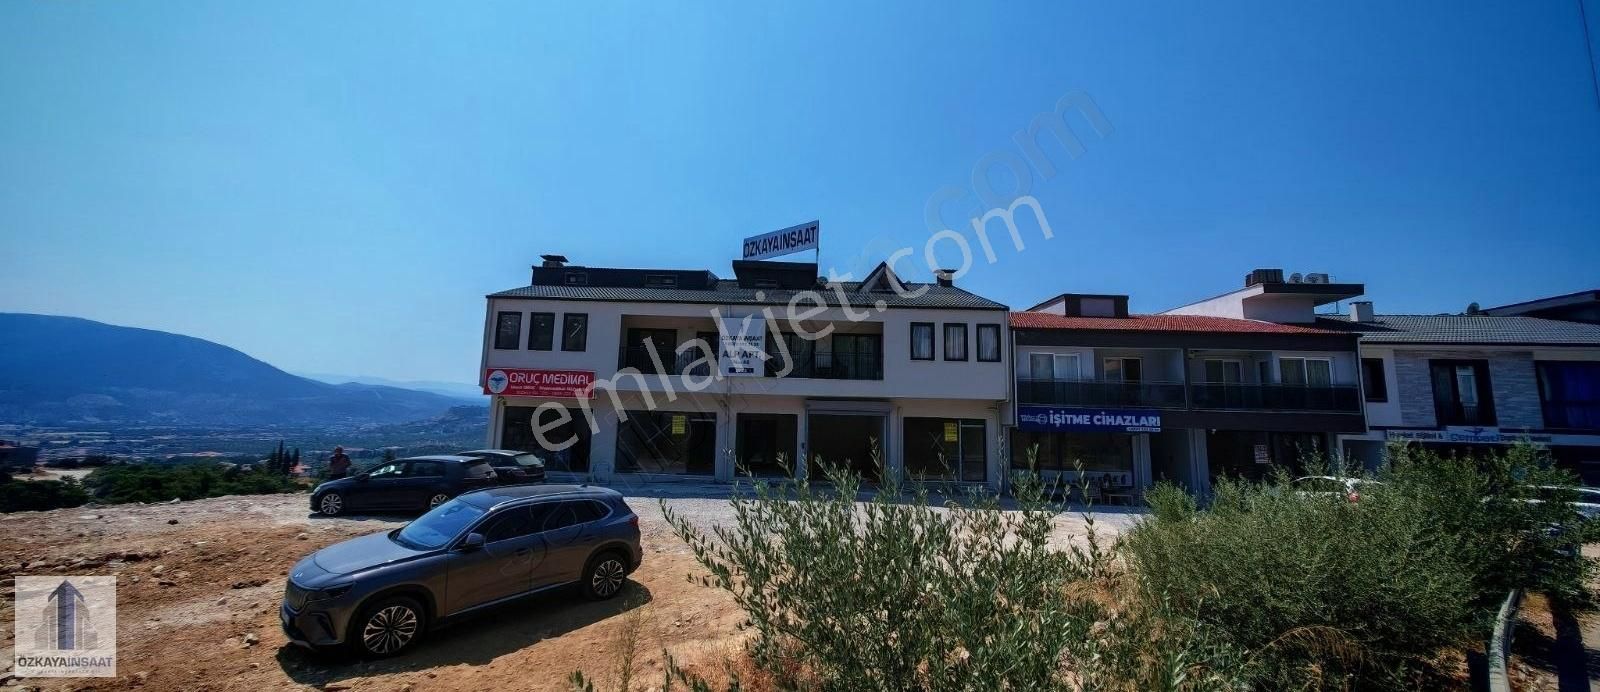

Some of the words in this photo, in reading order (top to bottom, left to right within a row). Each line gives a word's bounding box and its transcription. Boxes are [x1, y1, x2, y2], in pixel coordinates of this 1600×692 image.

[509, 372, 540, 385] ORUÇ
[542, 372, 590, 385] MEDİKAL
[1049, 410, 1091, 428] İŞİTME
[1093, 411, 1161, 427] CİHAZLARI
